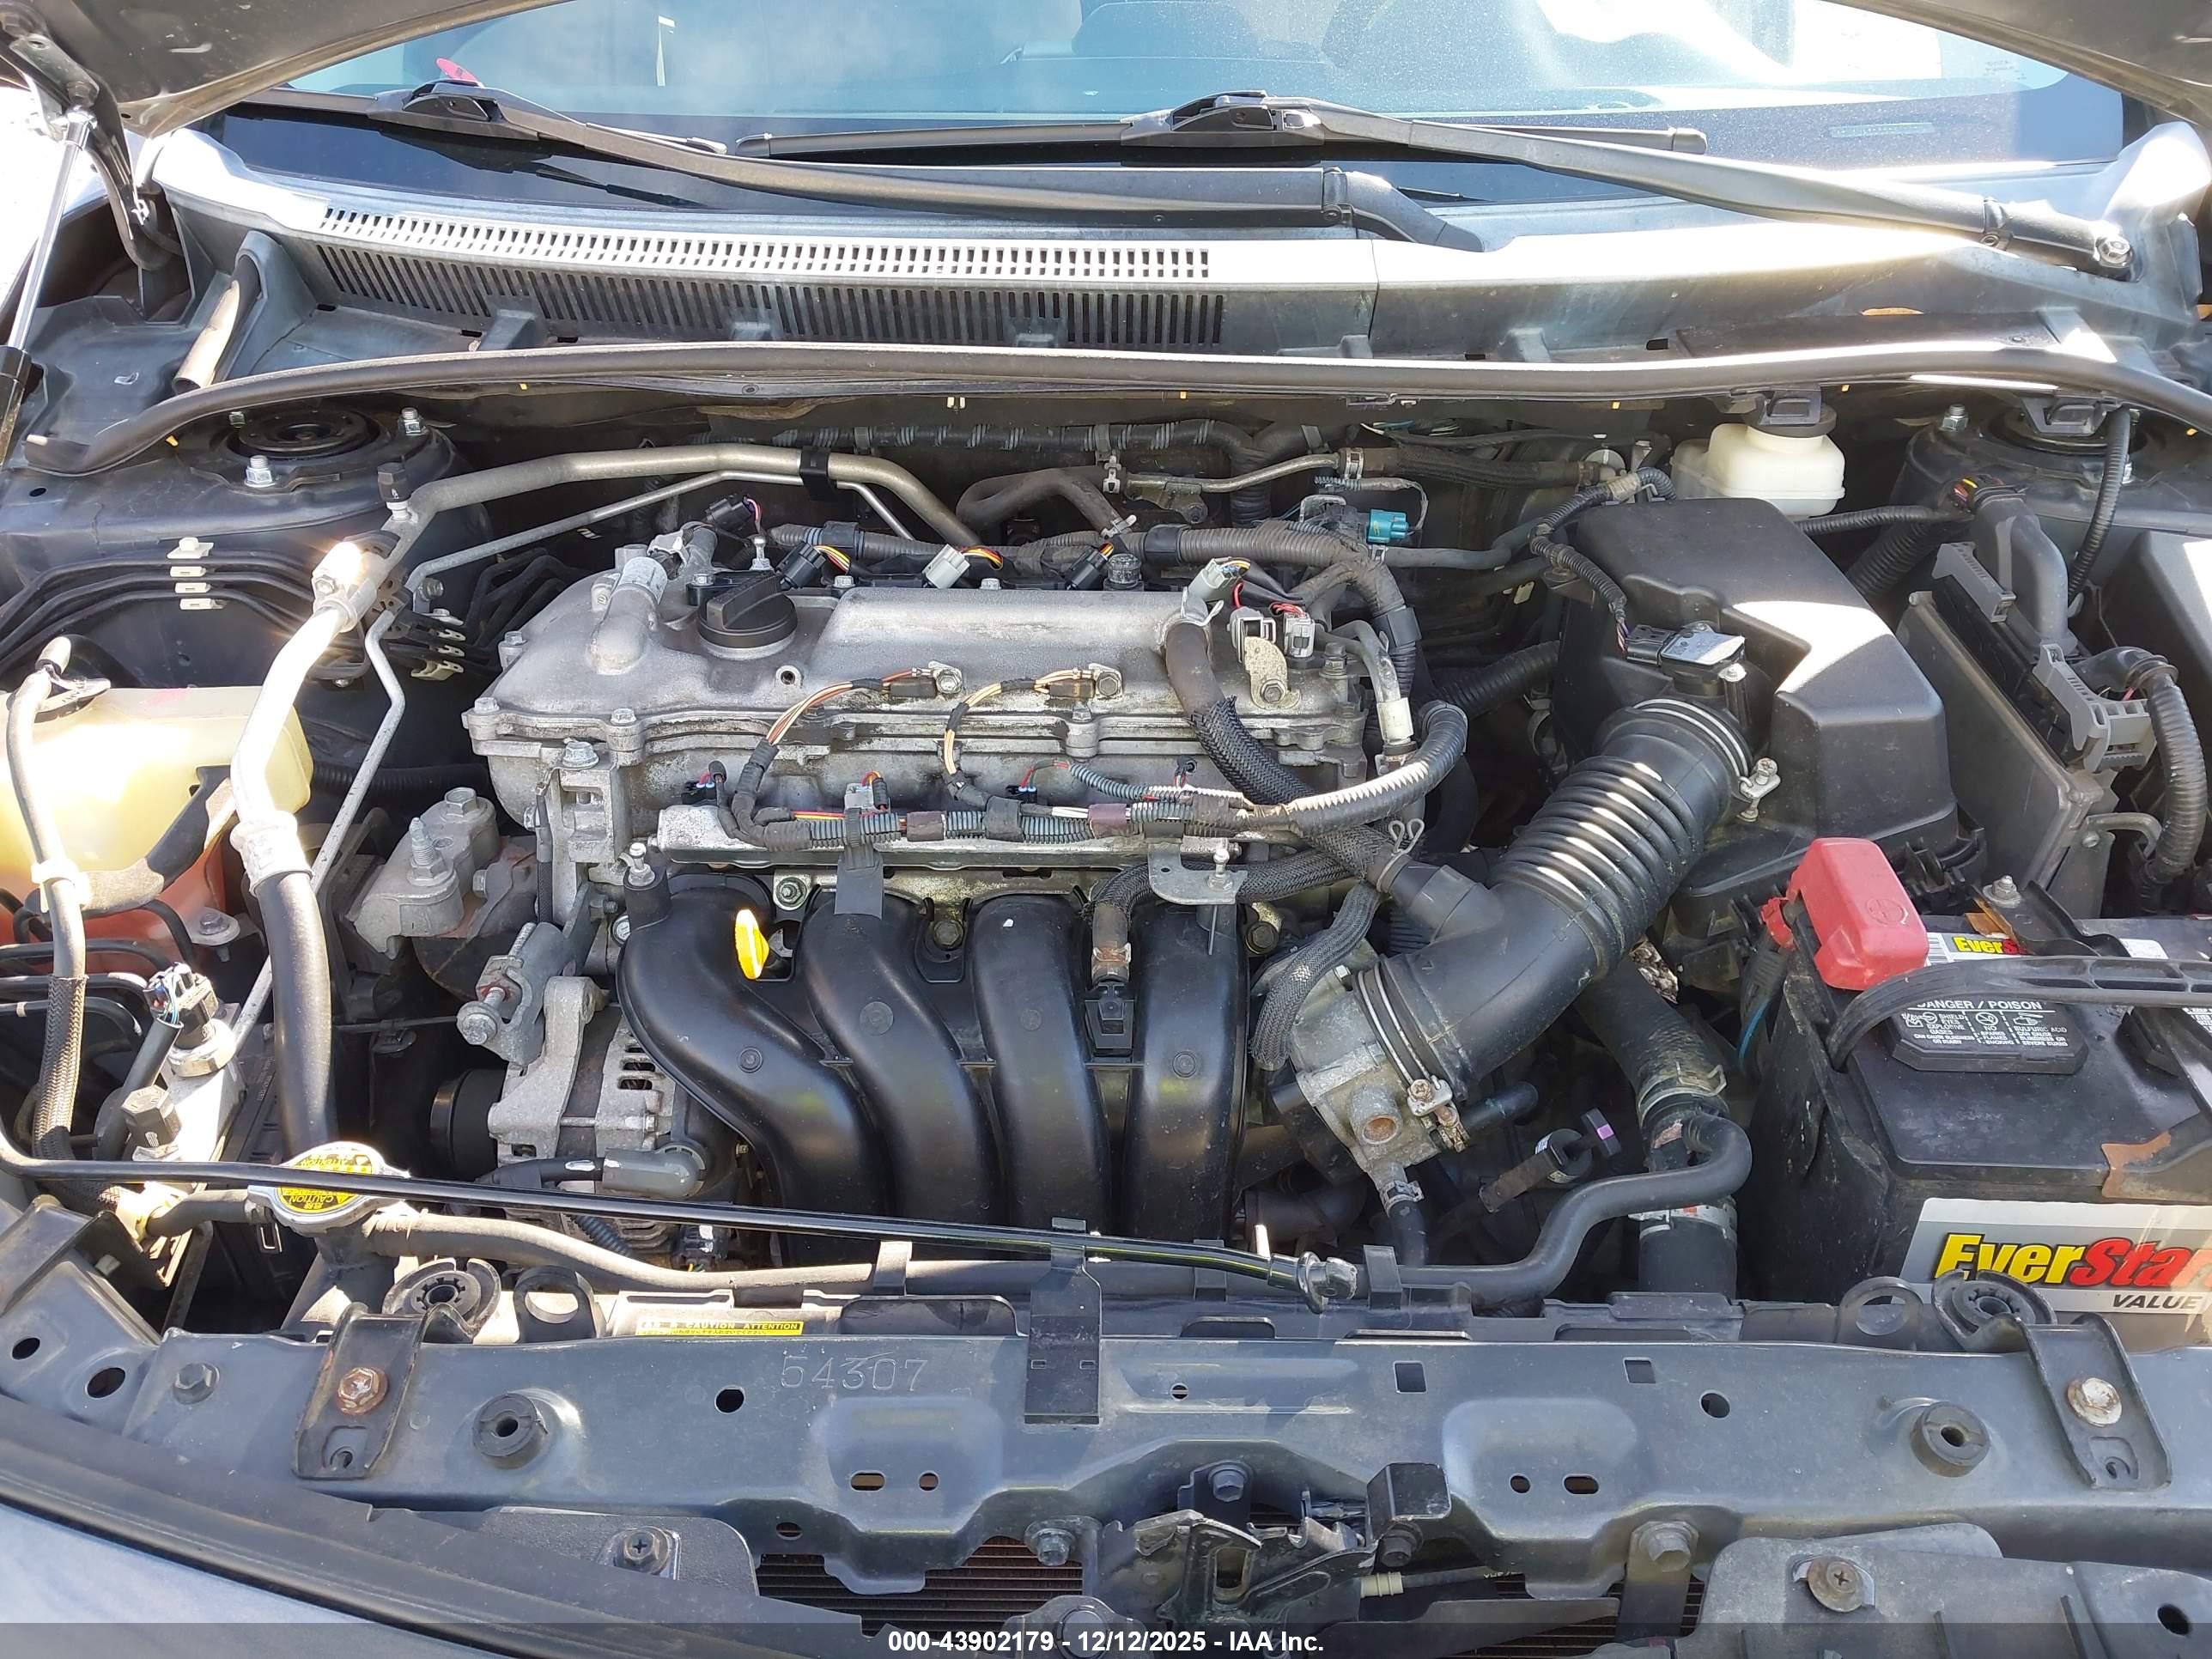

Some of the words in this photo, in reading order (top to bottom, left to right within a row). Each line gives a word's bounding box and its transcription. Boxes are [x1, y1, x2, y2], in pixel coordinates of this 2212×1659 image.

[1990, 1001, 2043, 1010] POISON
[289, 1194, 335, 1203] CAUTION
[1934, 1232, 2212, 1286] EverStar
[2112, 1293, 2203, 1310] VALUE
[781, 1355, 928, 1392] 54307
